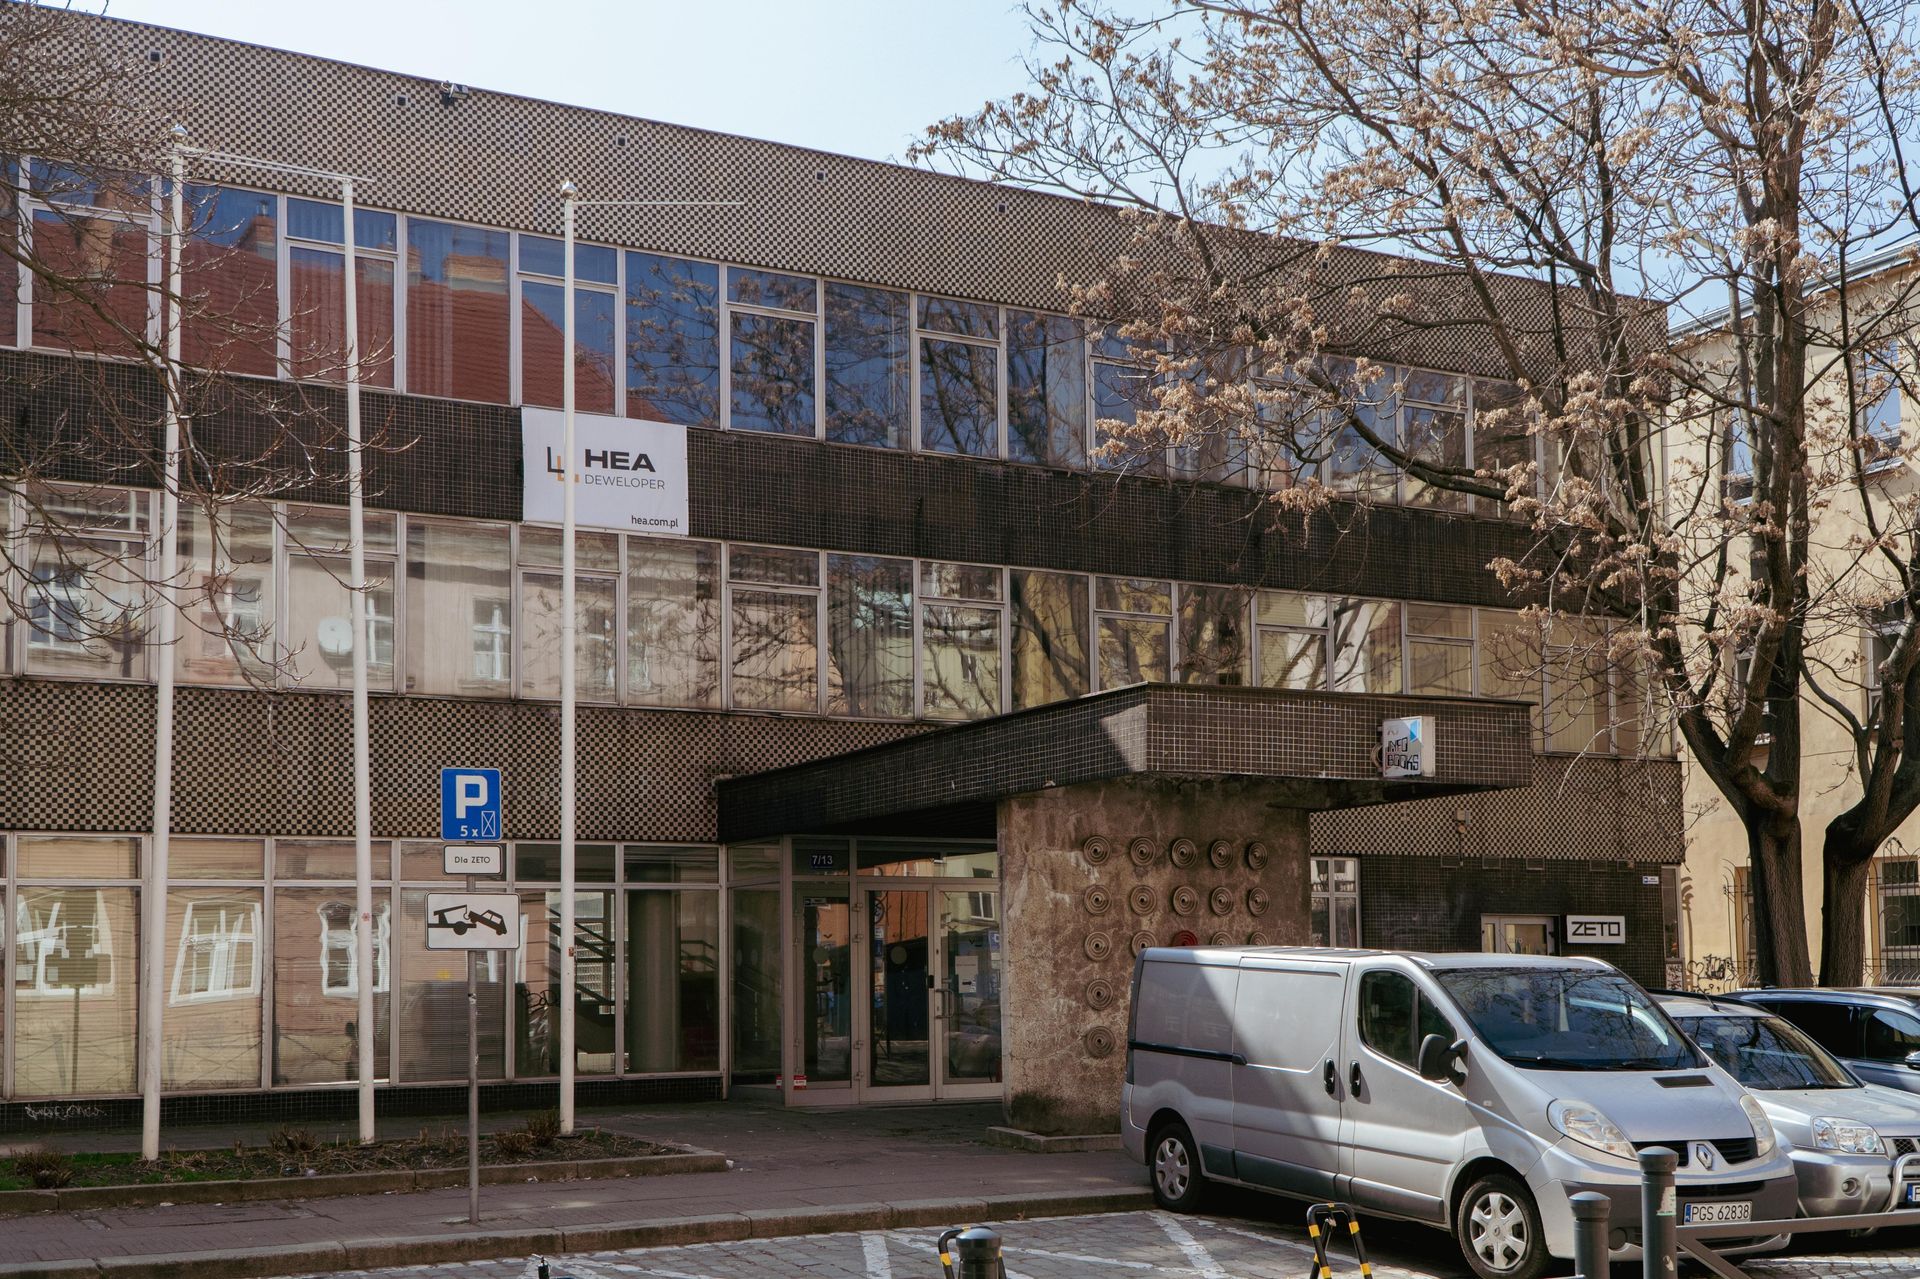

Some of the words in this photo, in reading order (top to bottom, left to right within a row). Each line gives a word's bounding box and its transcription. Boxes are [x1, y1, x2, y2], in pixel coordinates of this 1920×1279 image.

[584, 449, 656, 473] HEA
[584, 474, 666, 490] DEWELOPER
[631, 515, 679, 529] hea.com.pl
[455, 775, 488, 819] P
[460, 825, 469, 837] 5
[454, 856, 469, 864] Dla
[471, 856, 491, 864] ZETO
[812, 855, 833, 865] 7/13
[1571, 921, 1620, 937] ZETO
[1691, 1206, 1714, 1221] PGS
[1717, 1204, 1750, 1221] 62838
